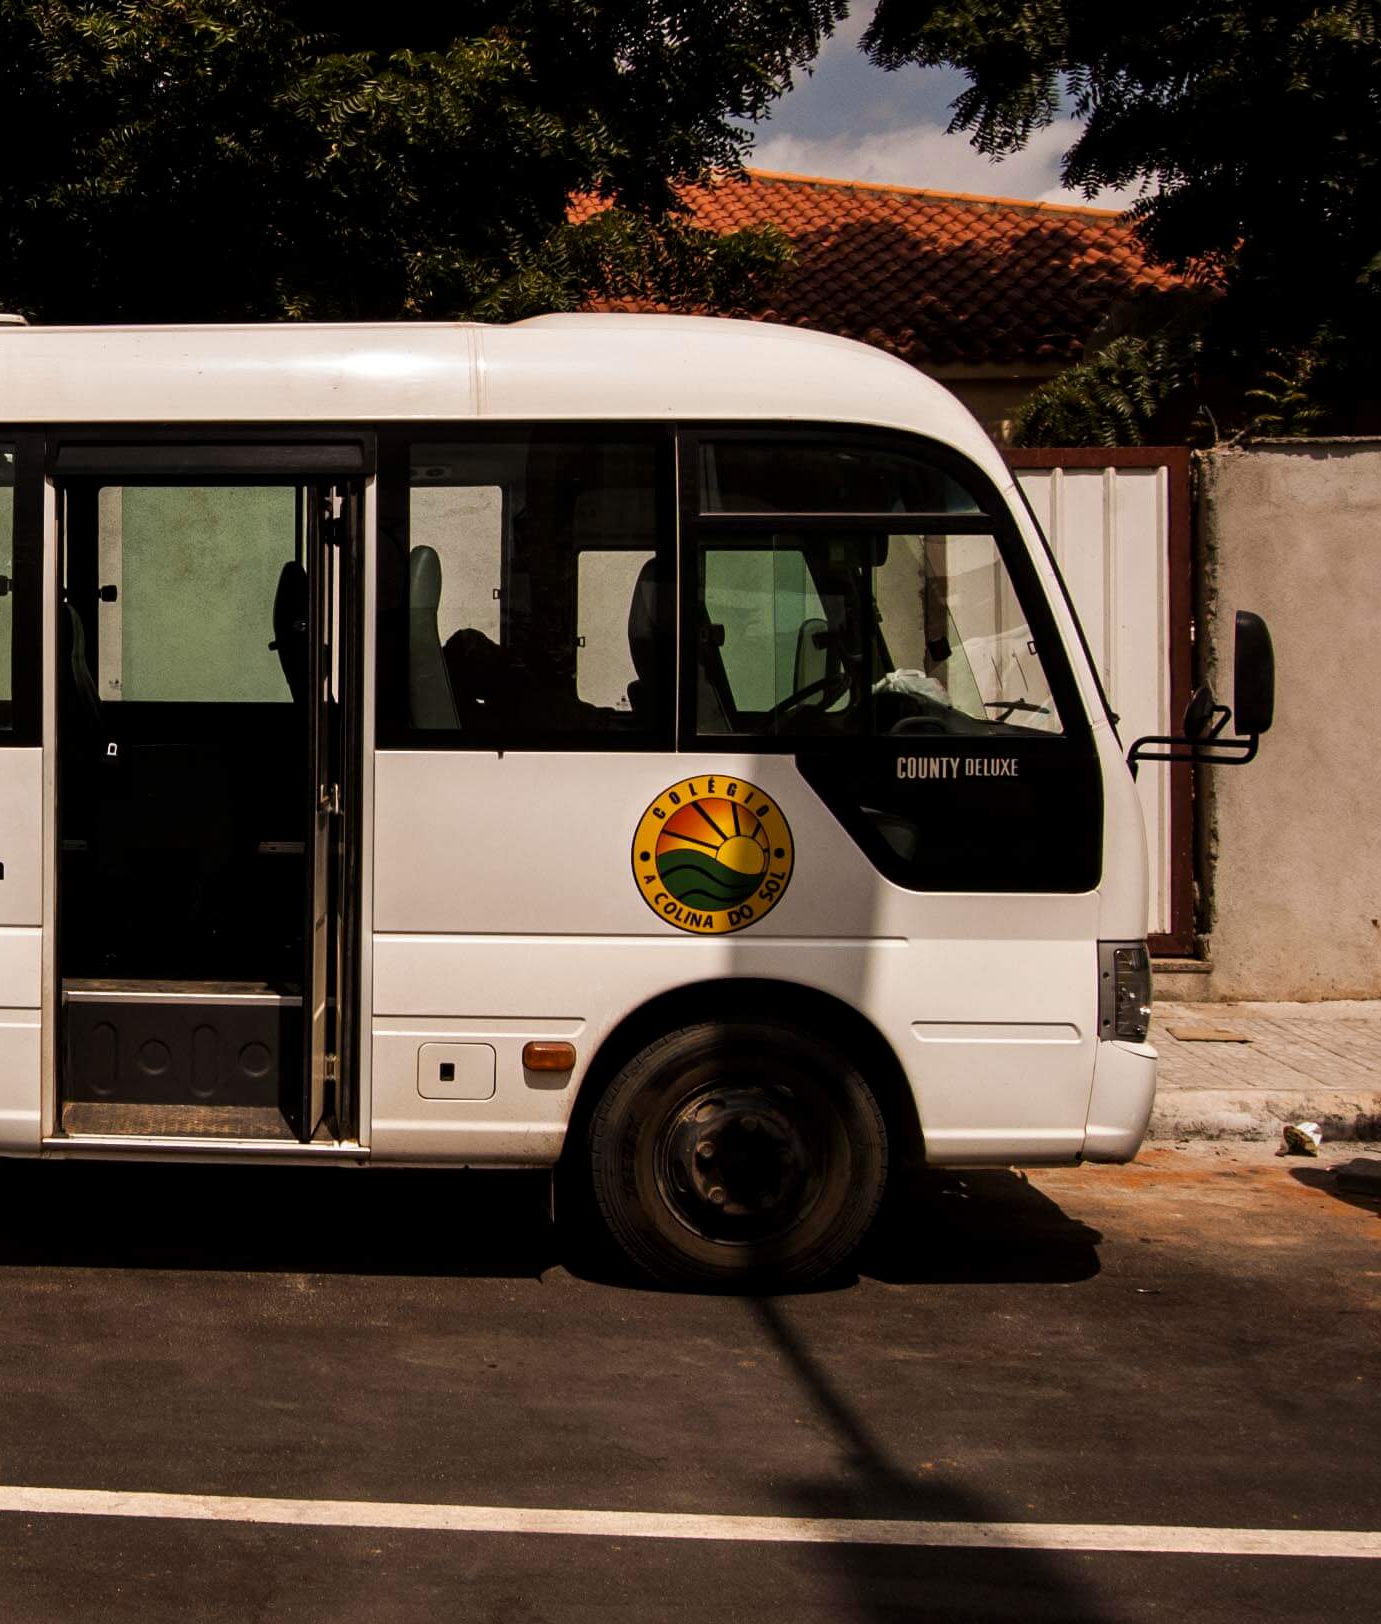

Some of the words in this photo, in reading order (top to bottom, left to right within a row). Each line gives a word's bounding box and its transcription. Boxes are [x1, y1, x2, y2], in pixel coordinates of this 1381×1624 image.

[896, 757, 960, 779] COUNTY
[965, 758, 1019, 776] DELUXE
[652, 776, 770, 820] COLÉGIO
[643, 874, 656, 885] A
[654, 892, 714, 929] COLINA
[727, 904, 754, 927] DO
[759, 871, 786, 902] SOL
